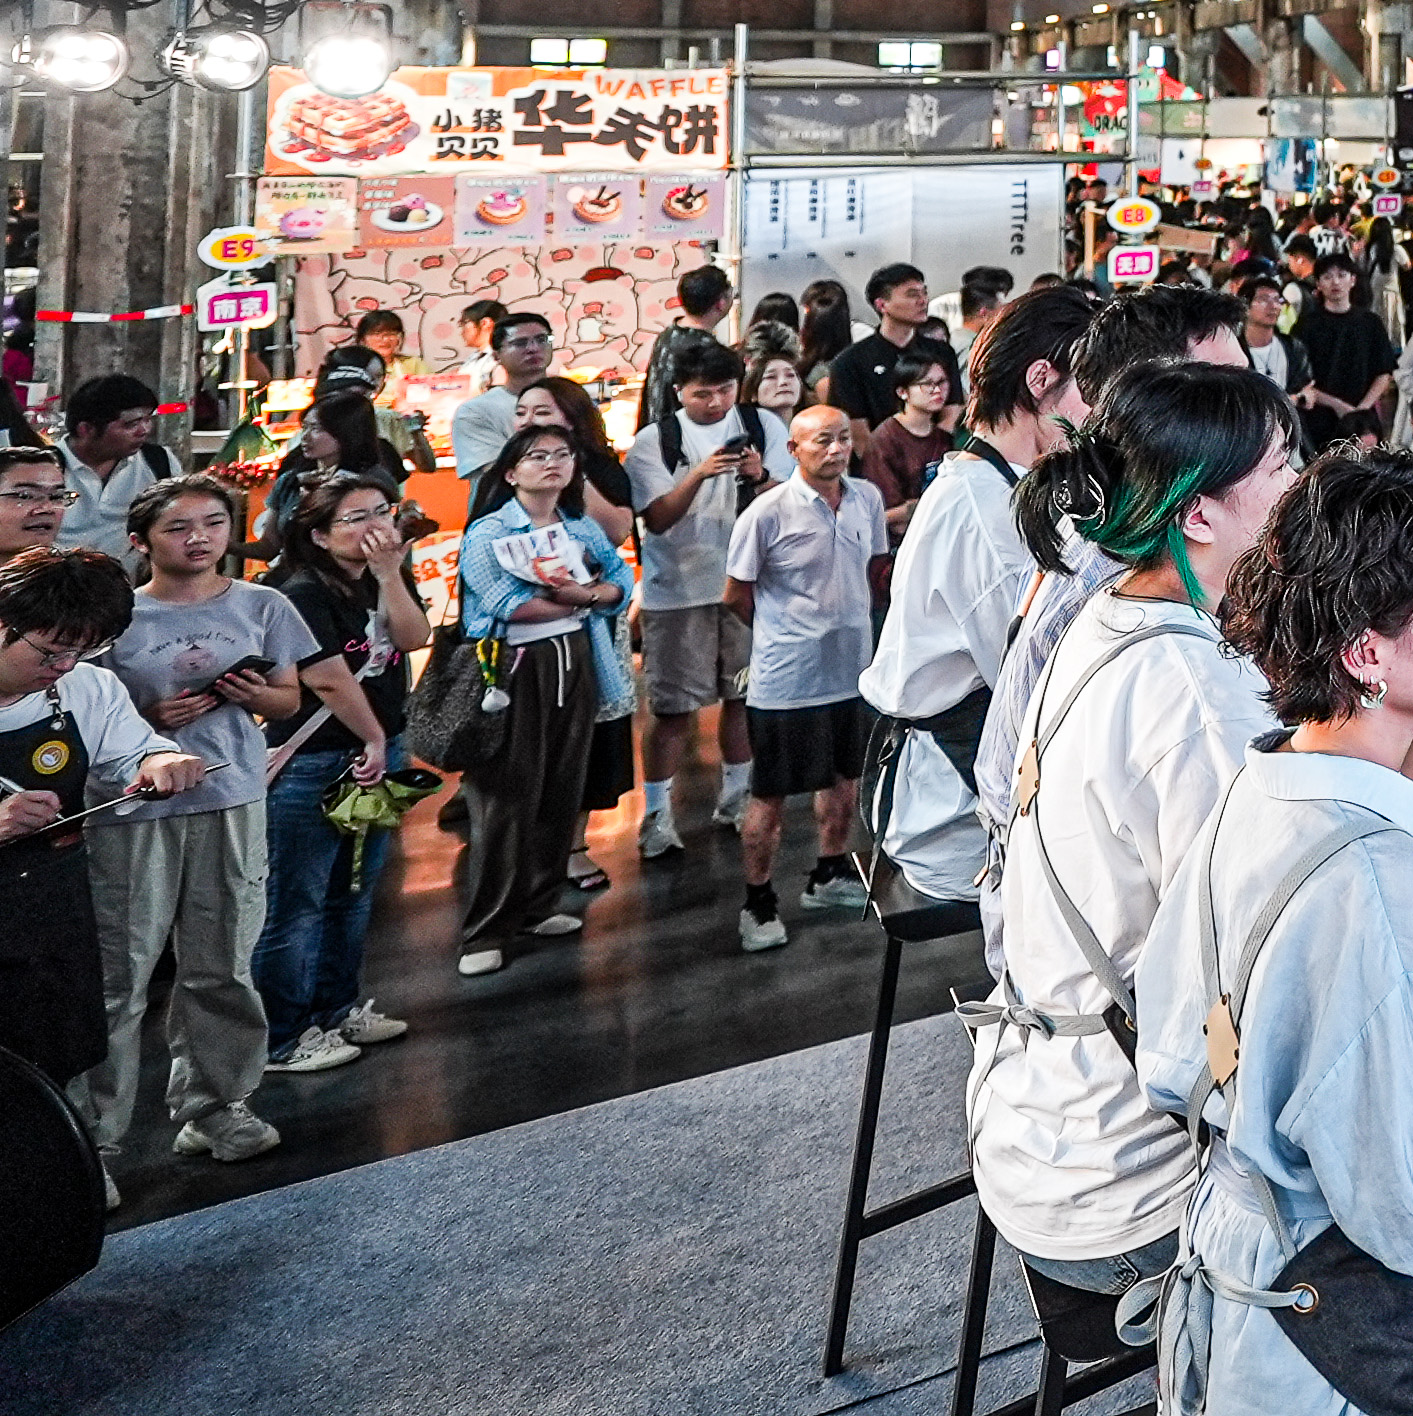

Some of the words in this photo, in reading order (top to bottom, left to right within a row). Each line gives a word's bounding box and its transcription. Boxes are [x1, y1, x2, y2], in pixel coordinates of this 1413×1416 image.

[595, 74, 723, 100] WAFFLE
[432, 108, 502, 132] 小猪
[513, 89, 718, 162] 华夫饼
[436, 136, 499, 159] 贝贝
[1123, 209, 1145, 223] E8
[222, 239, 253, 258] E9
[1118, 255, 1151, 274] 天津
[213, 297, 262, 321] 南京
